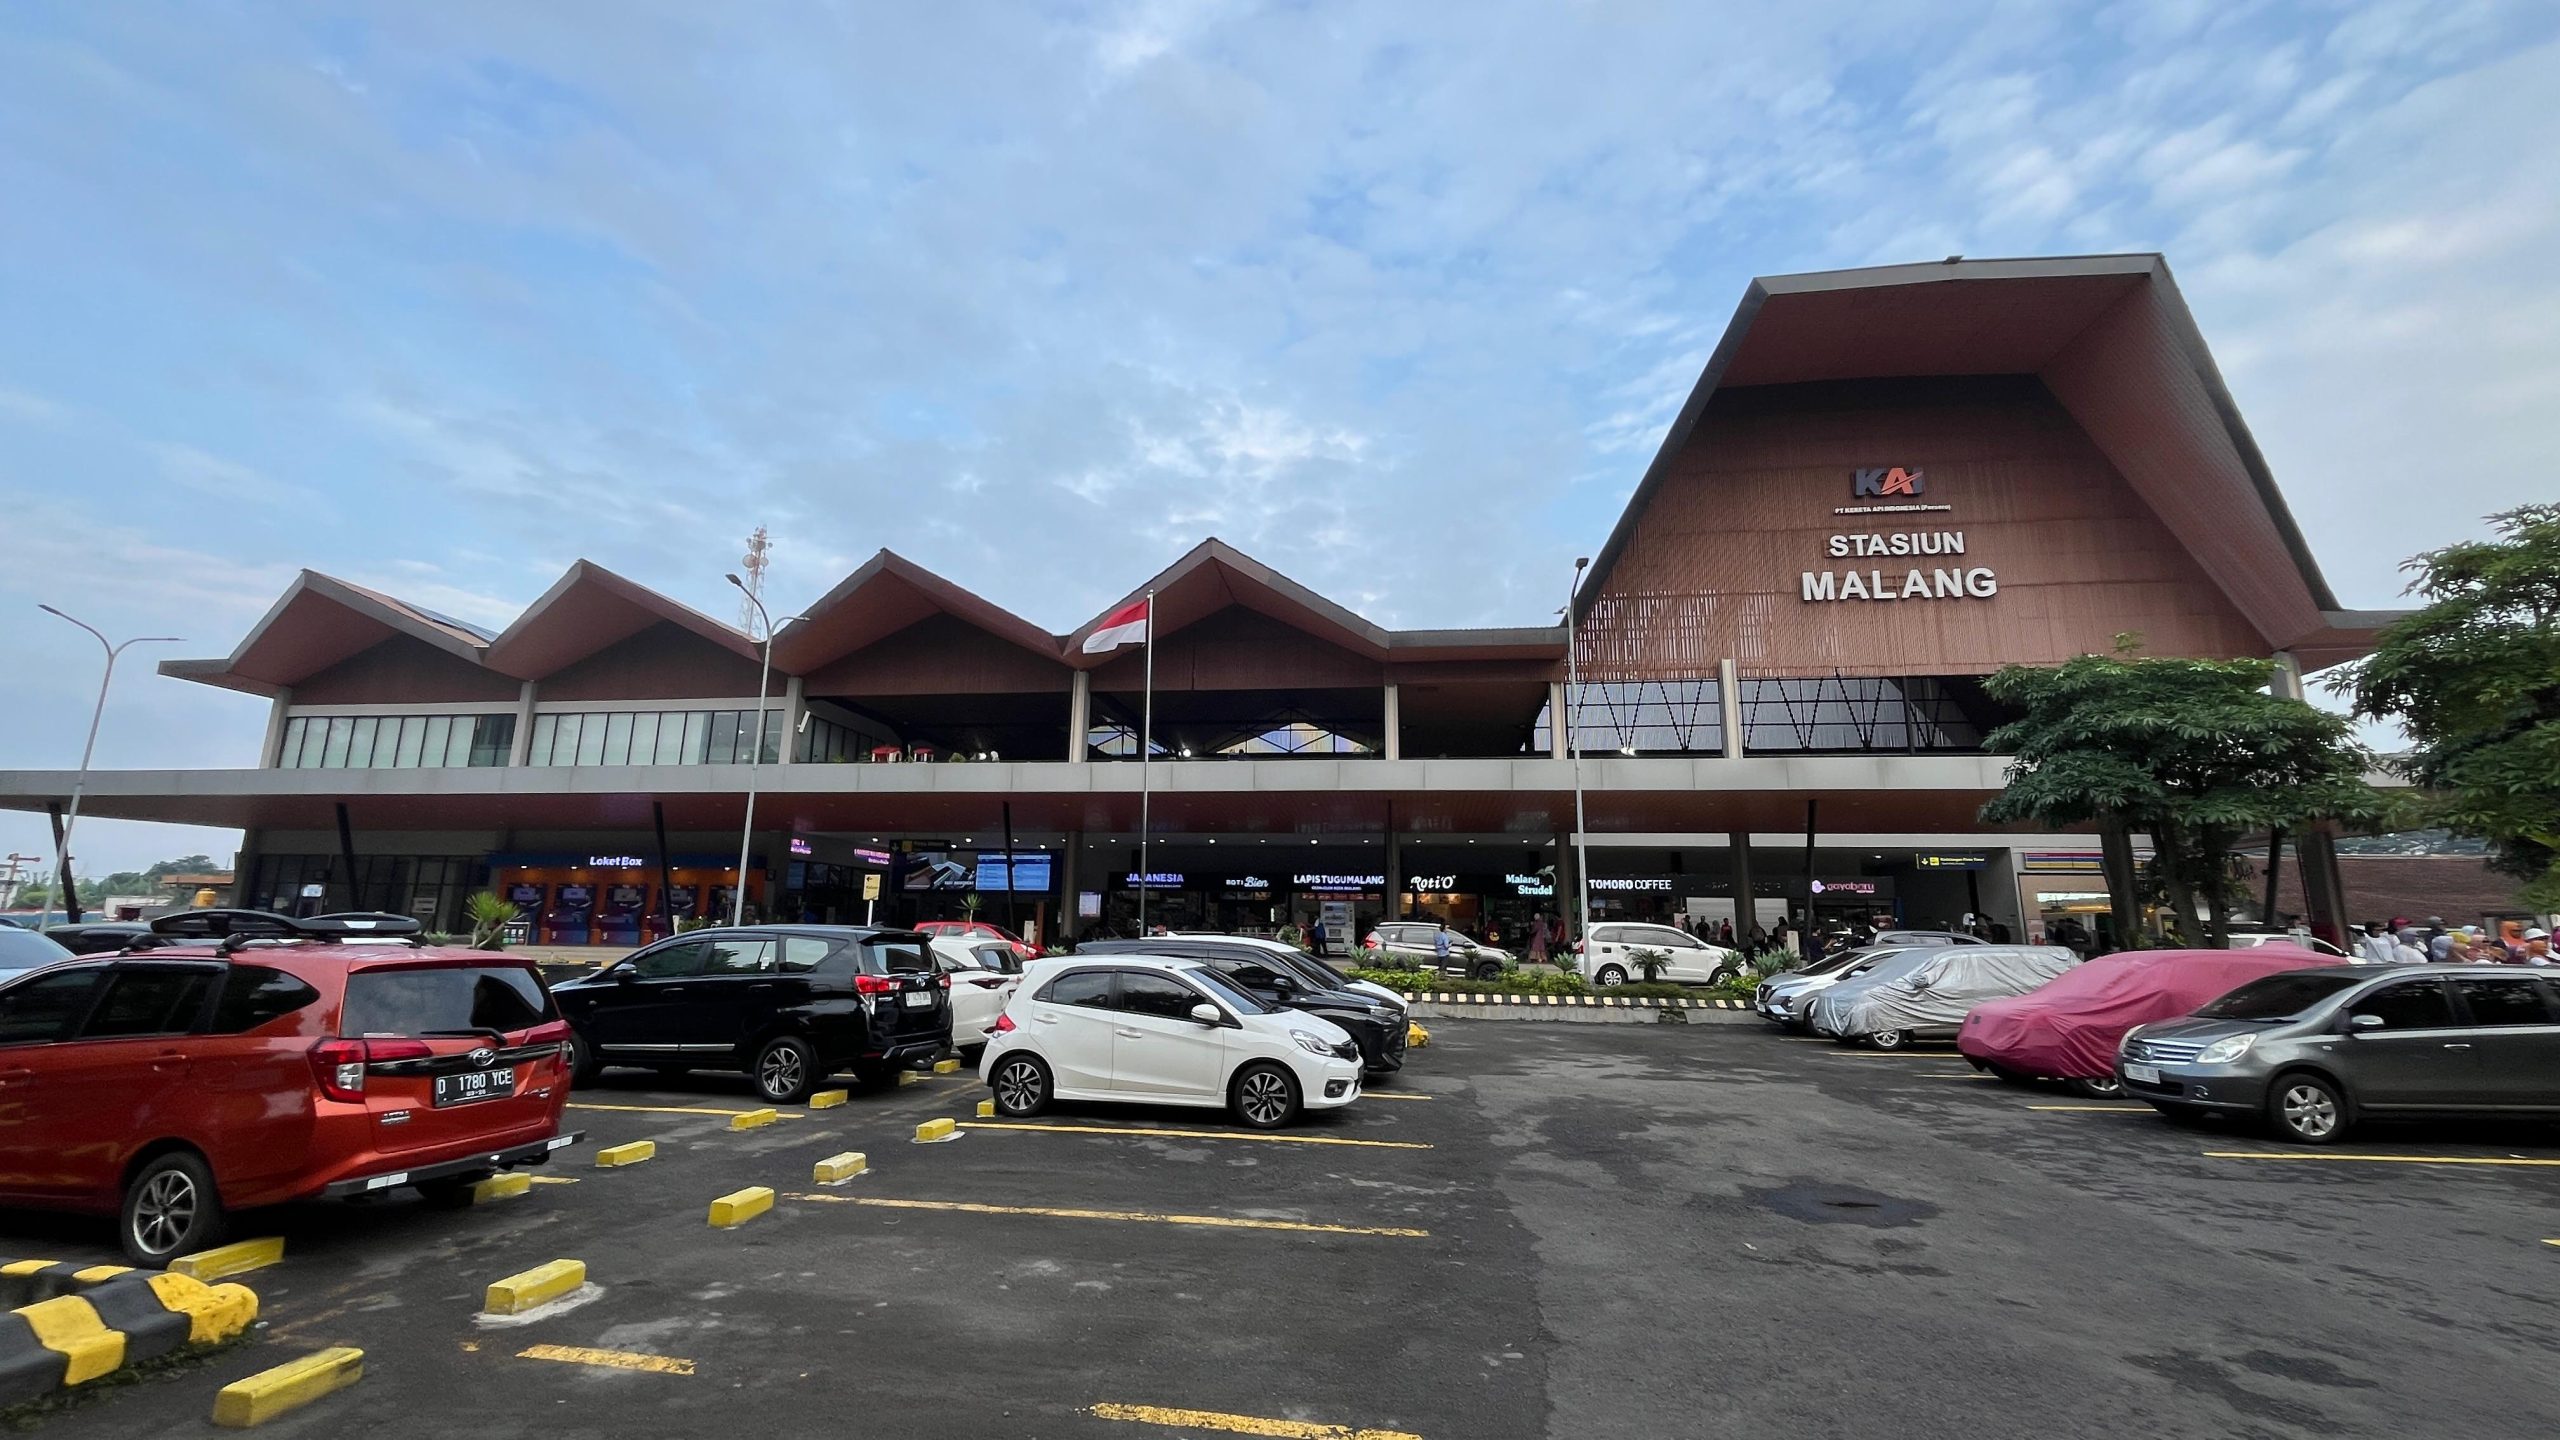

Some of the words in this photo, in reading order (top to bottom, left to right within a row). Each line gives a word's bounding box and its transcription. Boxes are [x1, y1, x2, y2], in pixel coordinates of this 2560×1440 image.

[1855, 467, 1924, 497] KAI
[1845, 506, 1872, 514] KERETA
[1872, 505, 1884, 513] API
[1884, 504, 1920, 513] INDONESIA
[1829, 531, 1965, 557] STASIUN
[1802, 567, 1998, 601] MALANG
[589, 856, 621, 866] Loket
[621, 856, 643, 866] Box
[1244, 876, 1270, 888] Bien
[1293, 874, 1320, 884] LAPIS
[1505, 874, 1540, 886] Malang
[1588, 879, 1634, 890] TOMORO
[1634, 879, 1672, 890] COFFEE
[1517, 885, 1553, 895] Strudel
[1826, 882, 1875, 891] gayabaru
[438, 1079, 446, 1095] D
[459, 1073, 486, 1091] 1780
[492, 1069, 513, 1087] YCE
